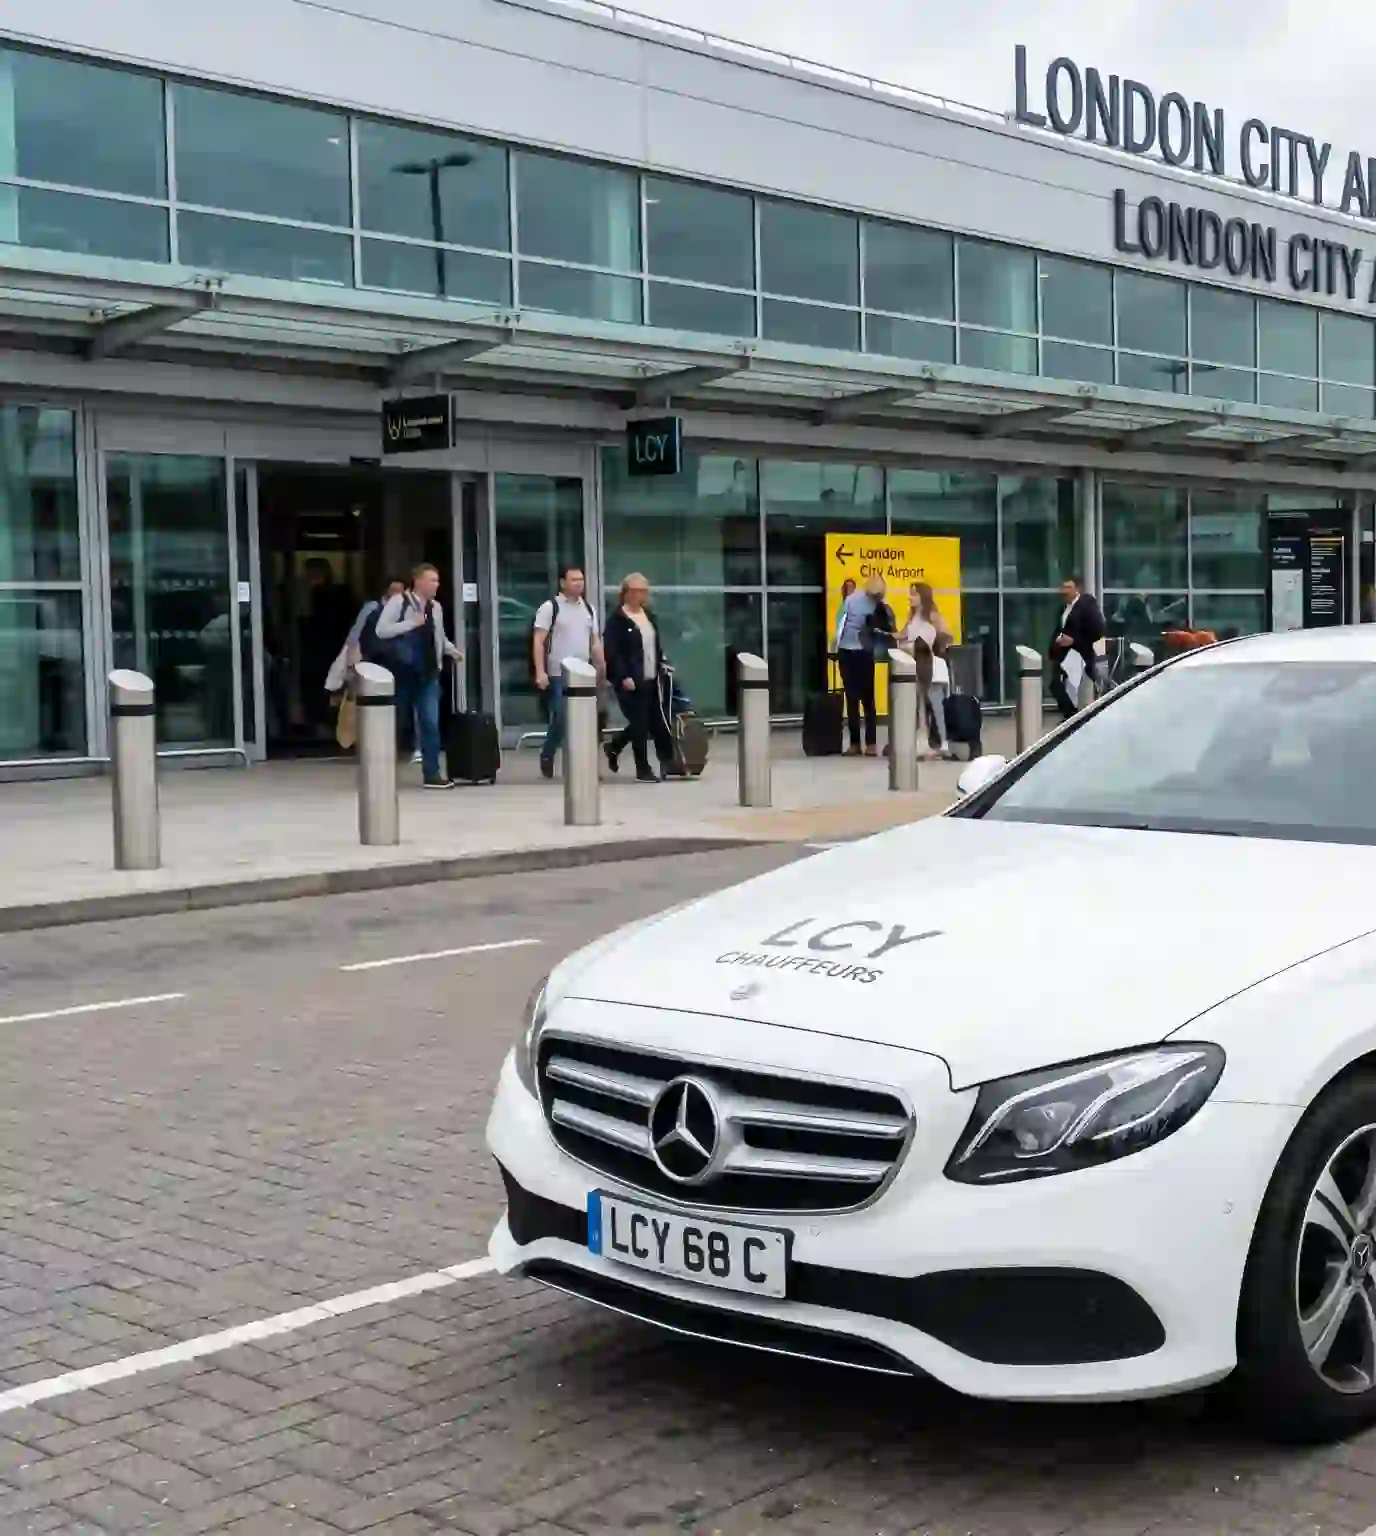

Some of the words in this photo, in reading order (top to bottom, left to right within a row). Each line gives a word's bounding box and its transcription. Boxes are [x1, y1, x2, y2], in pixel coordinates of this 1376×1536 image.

[1014, 44, 1225, 176] LONDON
[1240, 117, 1332, 205] CITY
[1113, 188, 1277, 283] LONDON
[1286, 233, 1364, 300] CITY
[635, 433, 669, 463] LCY
[859, 547, 905, 560] London
[859, 563, 884, 578] City
[887, 564, 925, 579] Airport
[760, 917, 945, 959] LCY
[715, 951, 885, 984] CHAUFFEURS
[610, 1206, 671, 1265] LCY
[682, 1226, 731, 1279] 68
[743, 1236, 768, 1284] C
